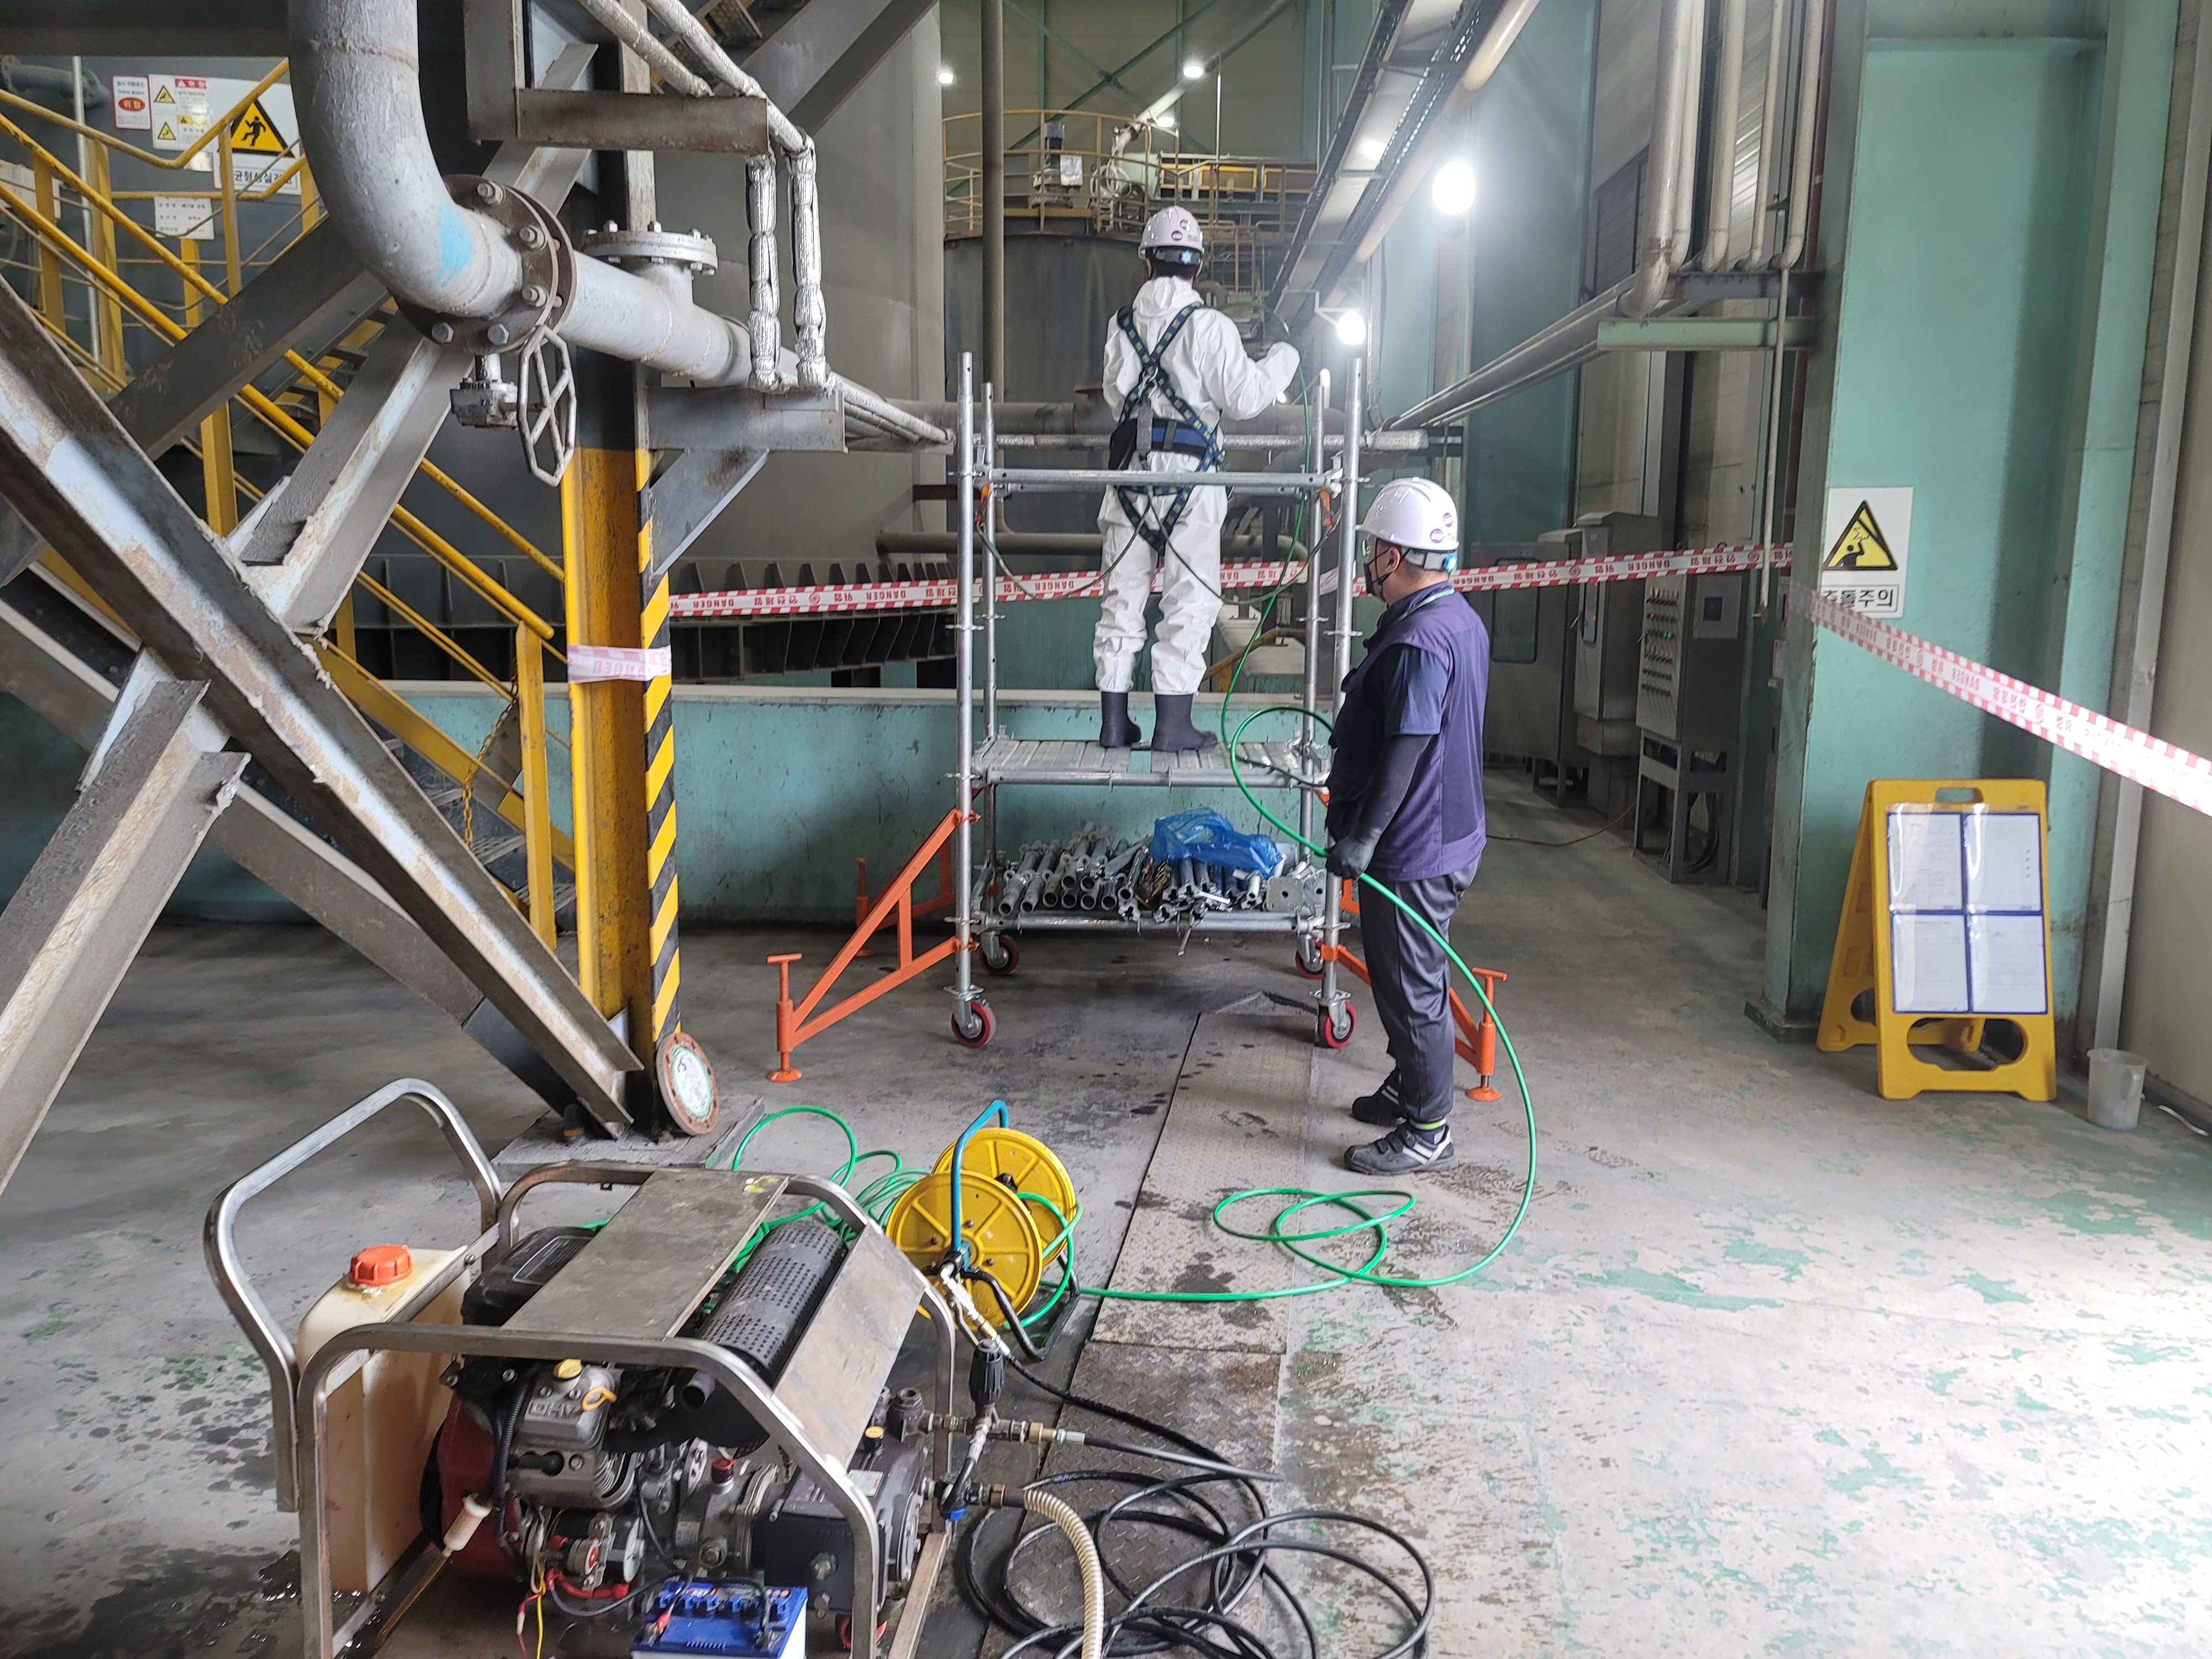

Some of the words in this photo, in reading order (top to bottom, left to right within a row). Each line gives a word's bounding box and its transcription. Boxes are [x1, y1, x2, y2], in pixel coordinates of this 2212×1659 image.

[1628, 560, 1670, 571] DANGER
[1219, 571, 1239, 581] DAN
[1453, 575, 1494, 585] DANGER
[1034, 580, 1074, 591] DANGER
[865, 589, 906, 601] DANGER
[925, 587, 957, 598] 전제일
[693, 598, 734, 608] DANGER
[528, 1401, 578, 1420] OHV
